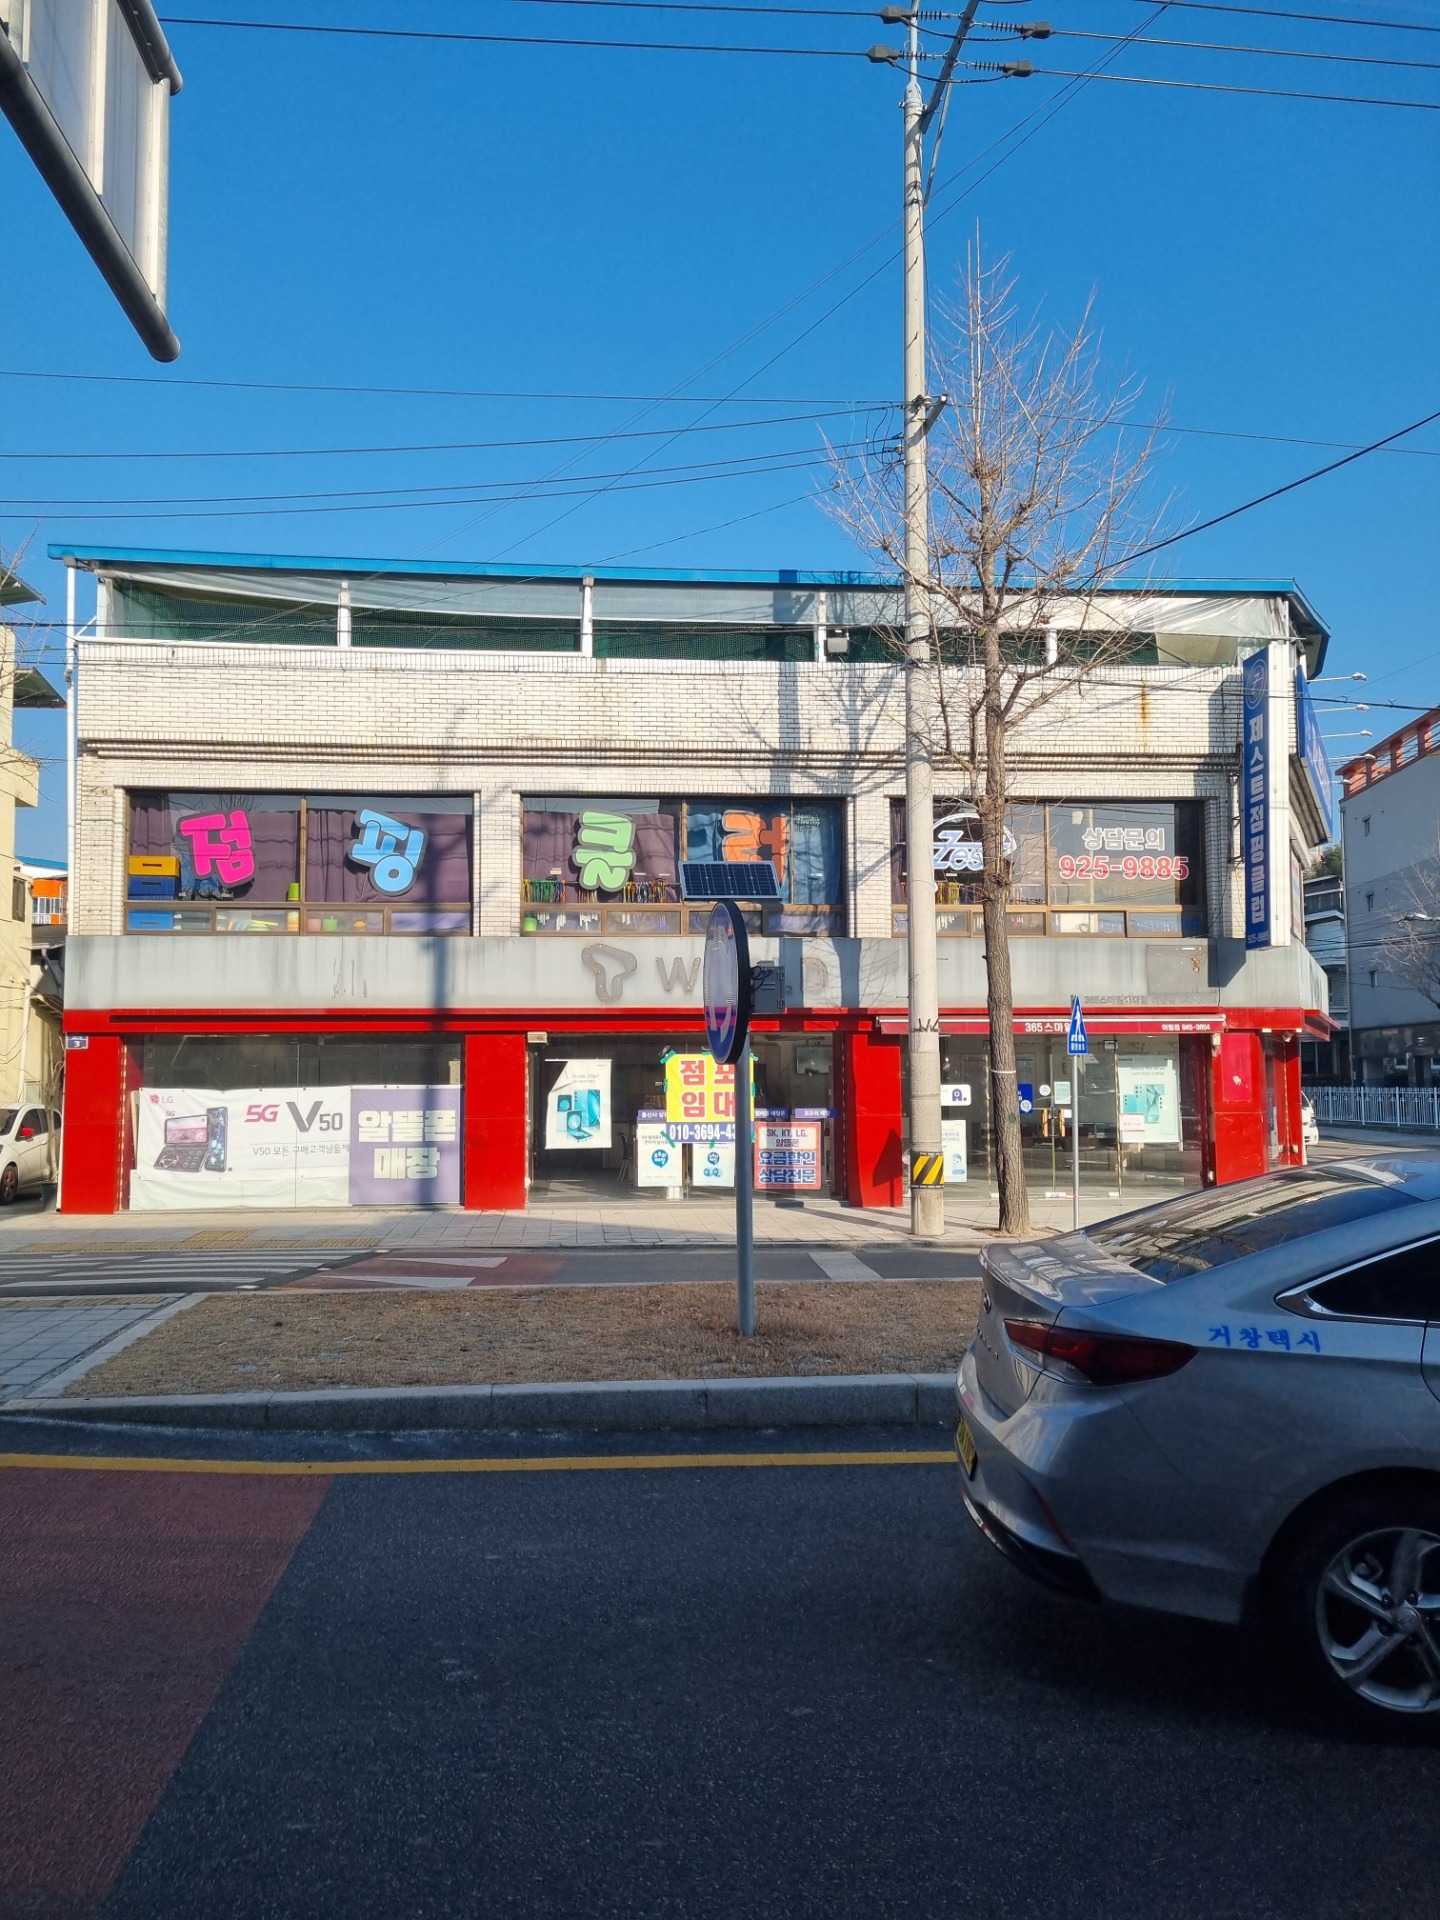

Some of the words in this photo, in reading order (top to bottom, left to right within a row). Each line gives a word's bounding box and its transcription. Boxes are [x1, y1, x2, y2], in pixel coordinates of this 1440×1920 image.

[1248, 713, 1266, 924] 제스트점핑클럽
[933, 830, 1002, 870] Zes
[1081, 826, 1166, 851] 상담문의
[1058, 854, 1190, 881] 925-9885
[73, 1040, 81, 1048] 3
[161, 1096, 174, 1104] LG
[244, 1104, 281, 1123] 5G
[286, 1100, 343, 1133] V50
[357, 1109, 456, 1143] 알뜰폰
[669, 1124, 736, 1140] 010-3694-43
[253, 1147, 271, 1156] V50
[273, 1146, 288, 1156] 모든
[373, 1145, 440, 1180] 매장
[759, 1150, 816, 1166] 요금할인
[759, 1168, 816, 1184] 상담전문
[1208, 1324, 1321, 1353] 거창택시
